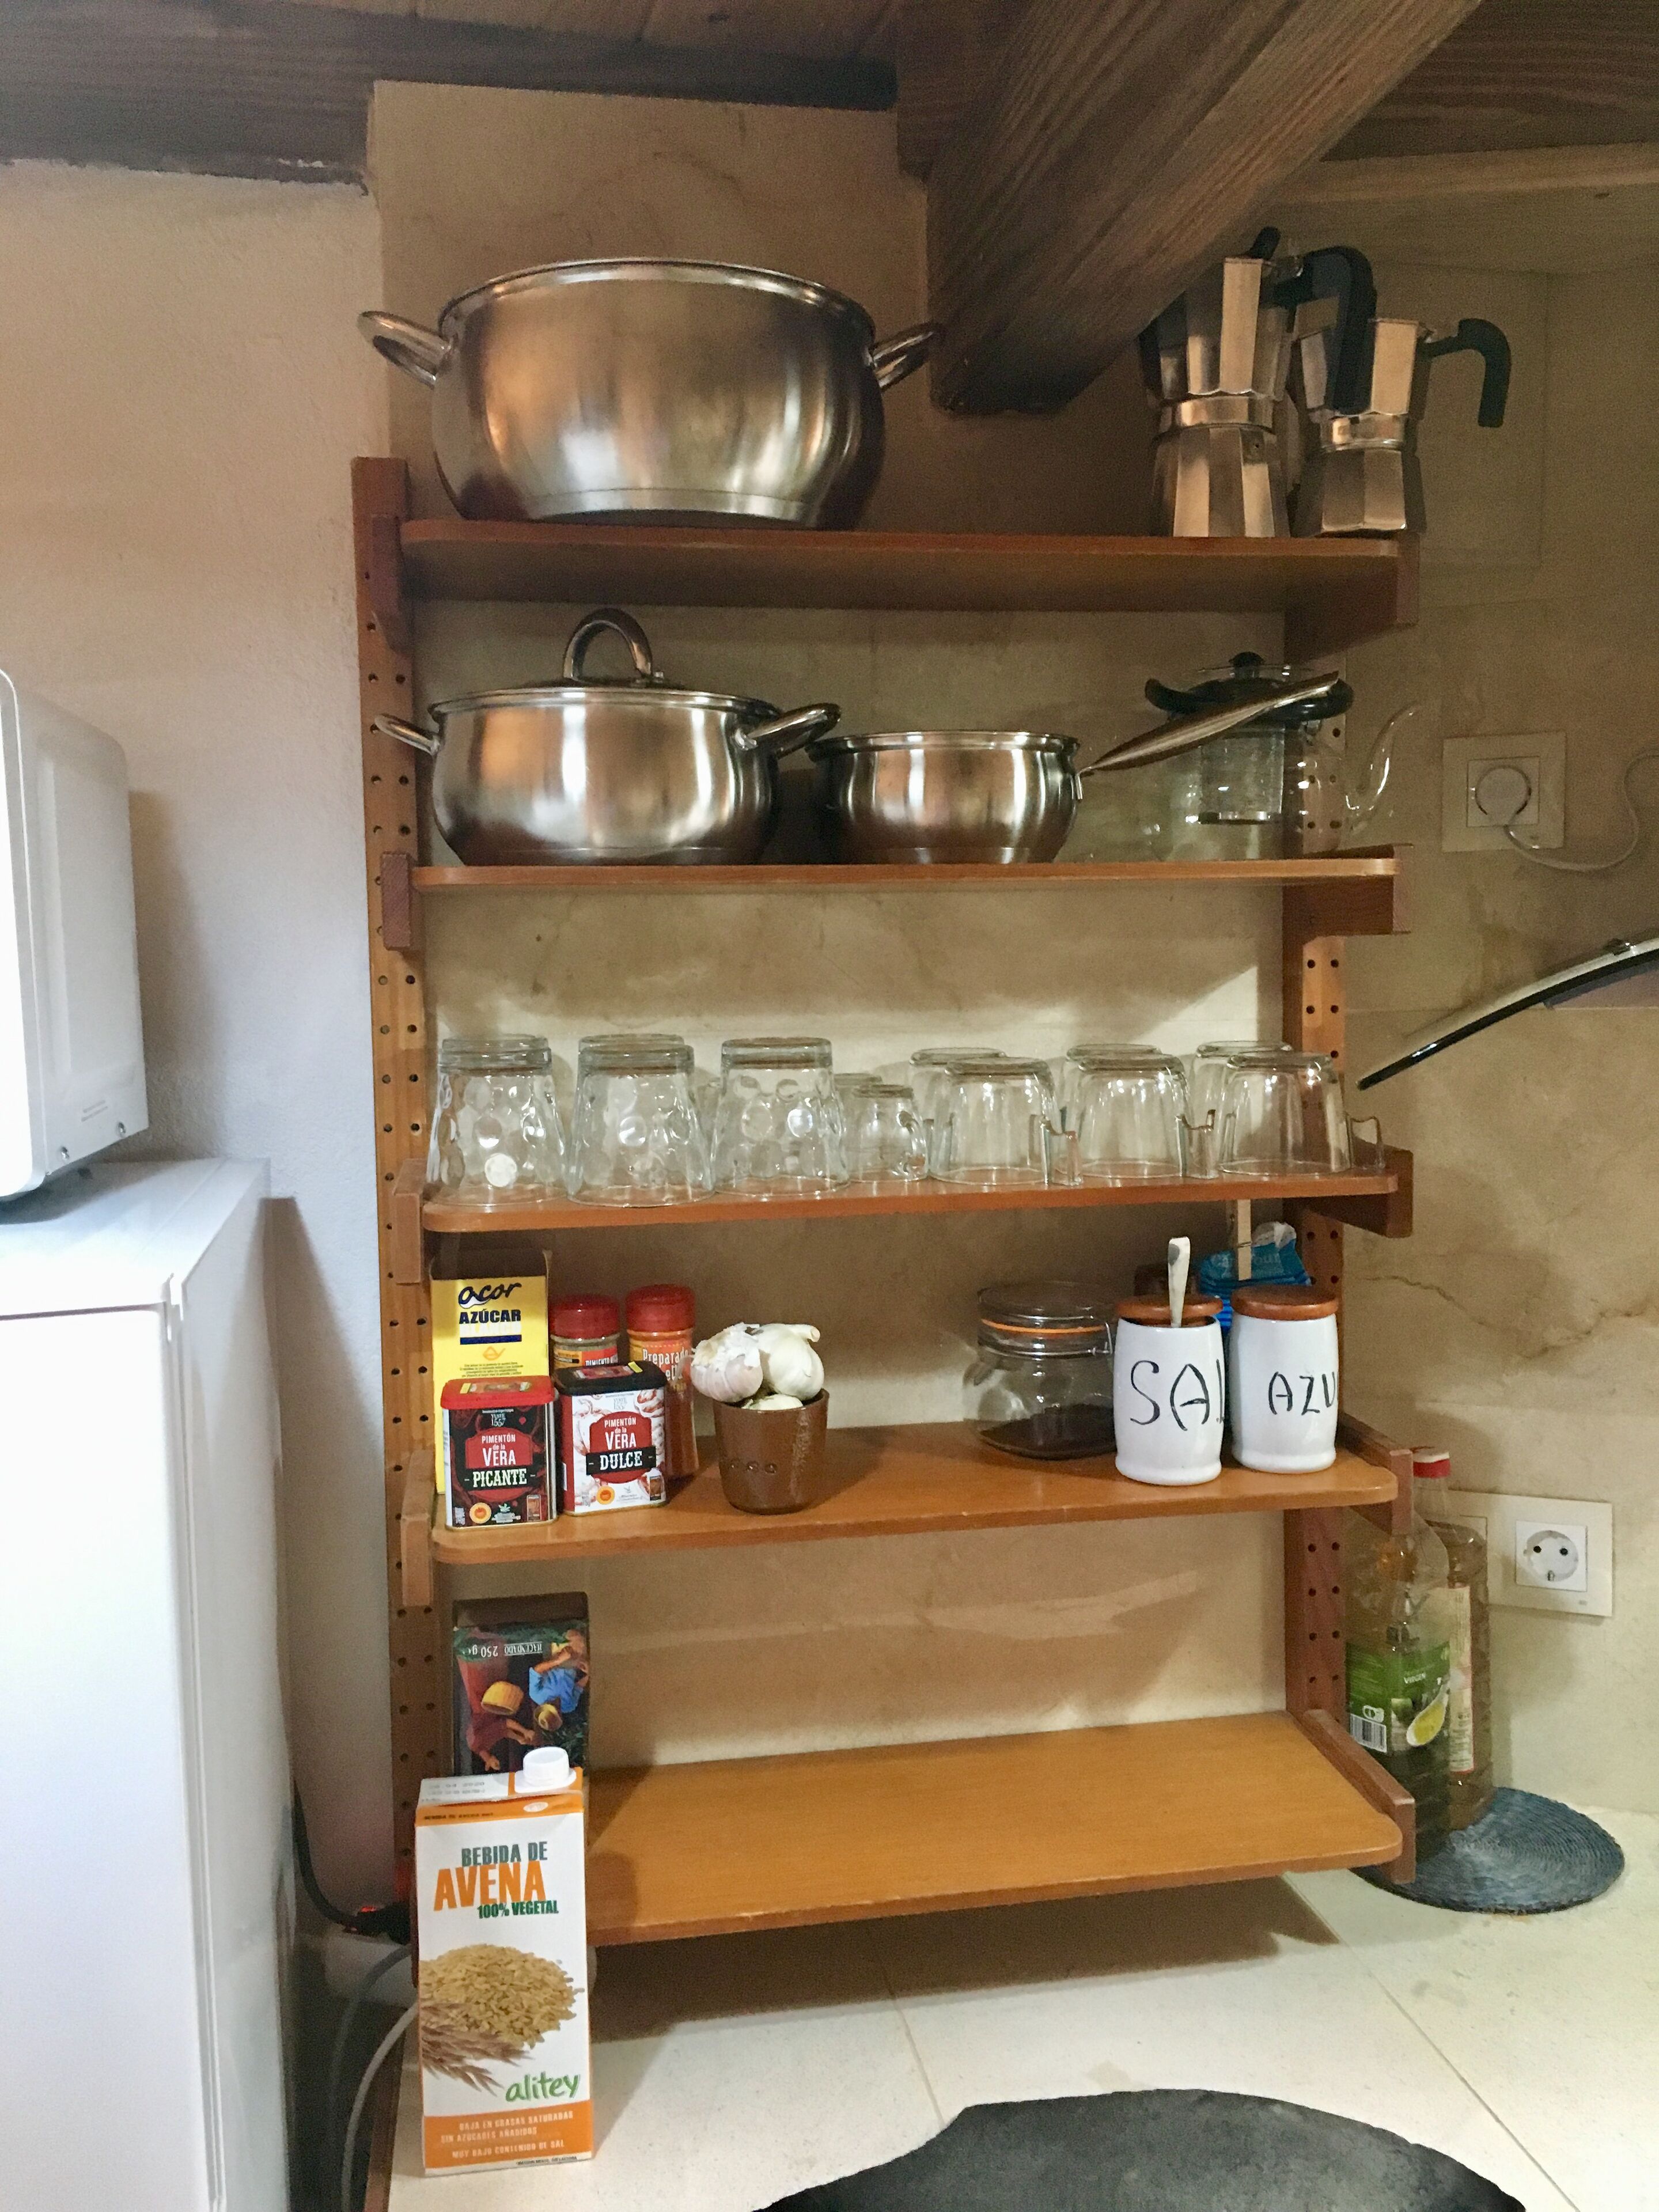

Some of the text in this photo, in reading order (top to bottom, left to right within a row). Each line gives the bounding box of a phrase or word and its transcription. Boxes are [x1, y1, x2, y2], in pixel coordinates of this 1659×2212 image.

[459, 1283, 522, 1306] acor
[459, 1309, 521, 1324] AZÚCAR
[604, 1416, 637, 1428] PIMENTÓN
[482, 1433, 516, 1444] PIMENTÓN
[605, 1431, 637, 1450] VERA
[482, 1448, 516, 1467] VERA
[600, 1450, 642, 1470] DULCE
[473, 1468, 527, 1487] PICANTE
[472, 1644, 478, 1655] g
[481, 1646, 498, 1657] 250
[461, 1842, 547, 1867] BEBIDA DE
[434, 1861, 546, 1911] AVENA
[478, 1900, 559, 1919] 100% VEGETAL
[505, 2071, 580, 2102] alitey
[459, 2111, 573, 2131] BAJA EN GRASAS SATURADAS
[441, 2135, 453, 2143] SIN
[452, 2150, 469, 2158] MUY
[472, 2147, 492, 2157] BAJO
[495, 2142, 536, 2154] CONTENIDO
[550, 2139, 565, 2147] SAL
